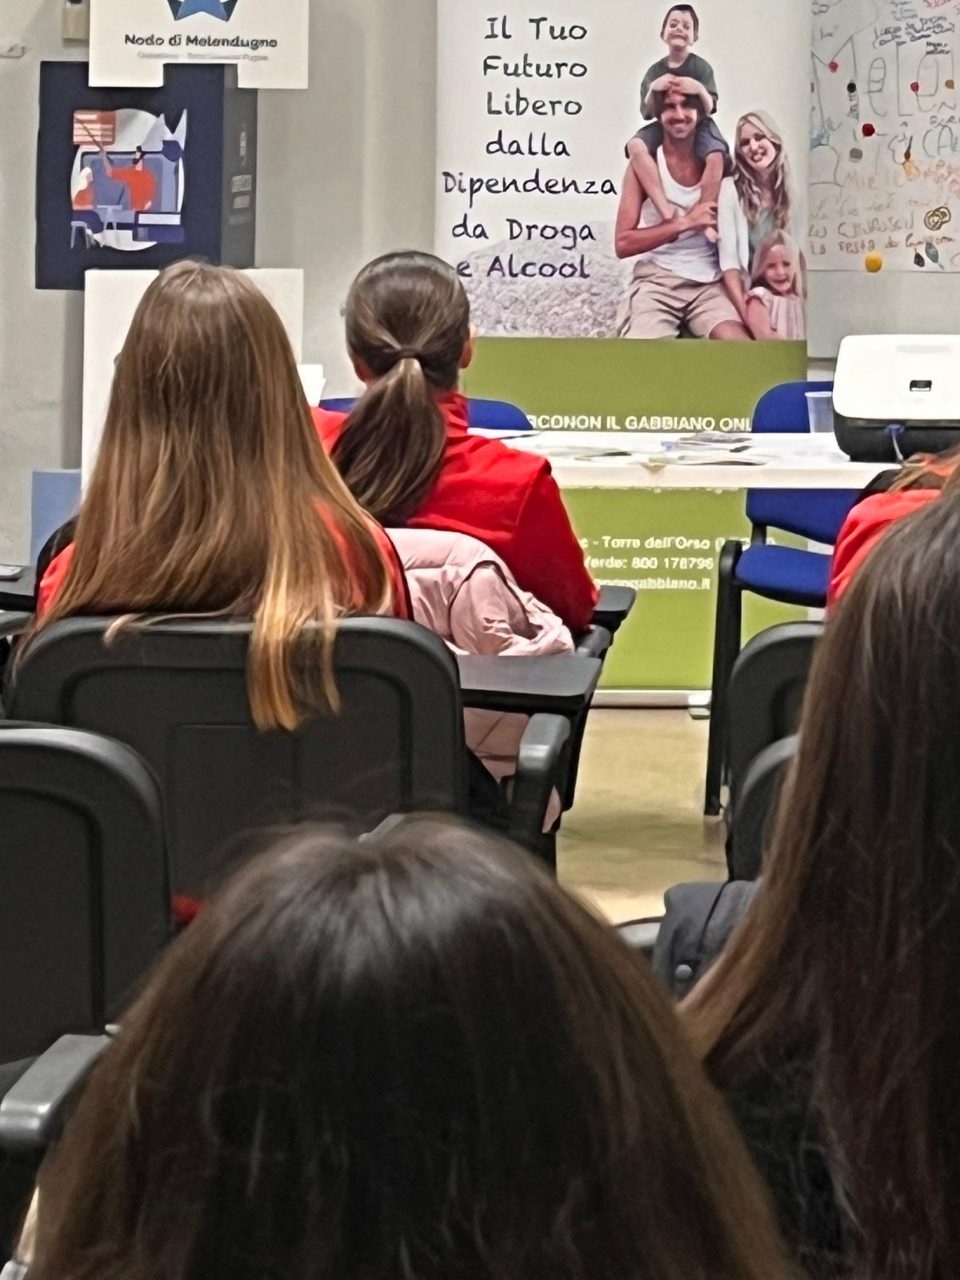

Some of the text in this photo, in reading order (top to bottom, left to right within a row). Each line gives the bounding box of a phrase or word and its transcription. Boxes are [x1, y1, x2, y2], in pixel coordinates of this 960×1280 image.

[484, 15, 588, 40] Il Tuo
[124, 34, 278, 51] Nodo di Melendugno
[483, 53, 588, 78] Futuro
[486, 87, 583, 116] Libero
[486, 129, 571, 157] dalla
[442, 168, 617, 208] Dipendenza
[452, 213, 596, 251] da Droga
[456, 253, 591, 279] e Alcool
[526, 414, 752, 433] RCONON IL GABBIANO ONL
[602, 536, 641, 549] Torre
[632, 557, 658, 569] 800
